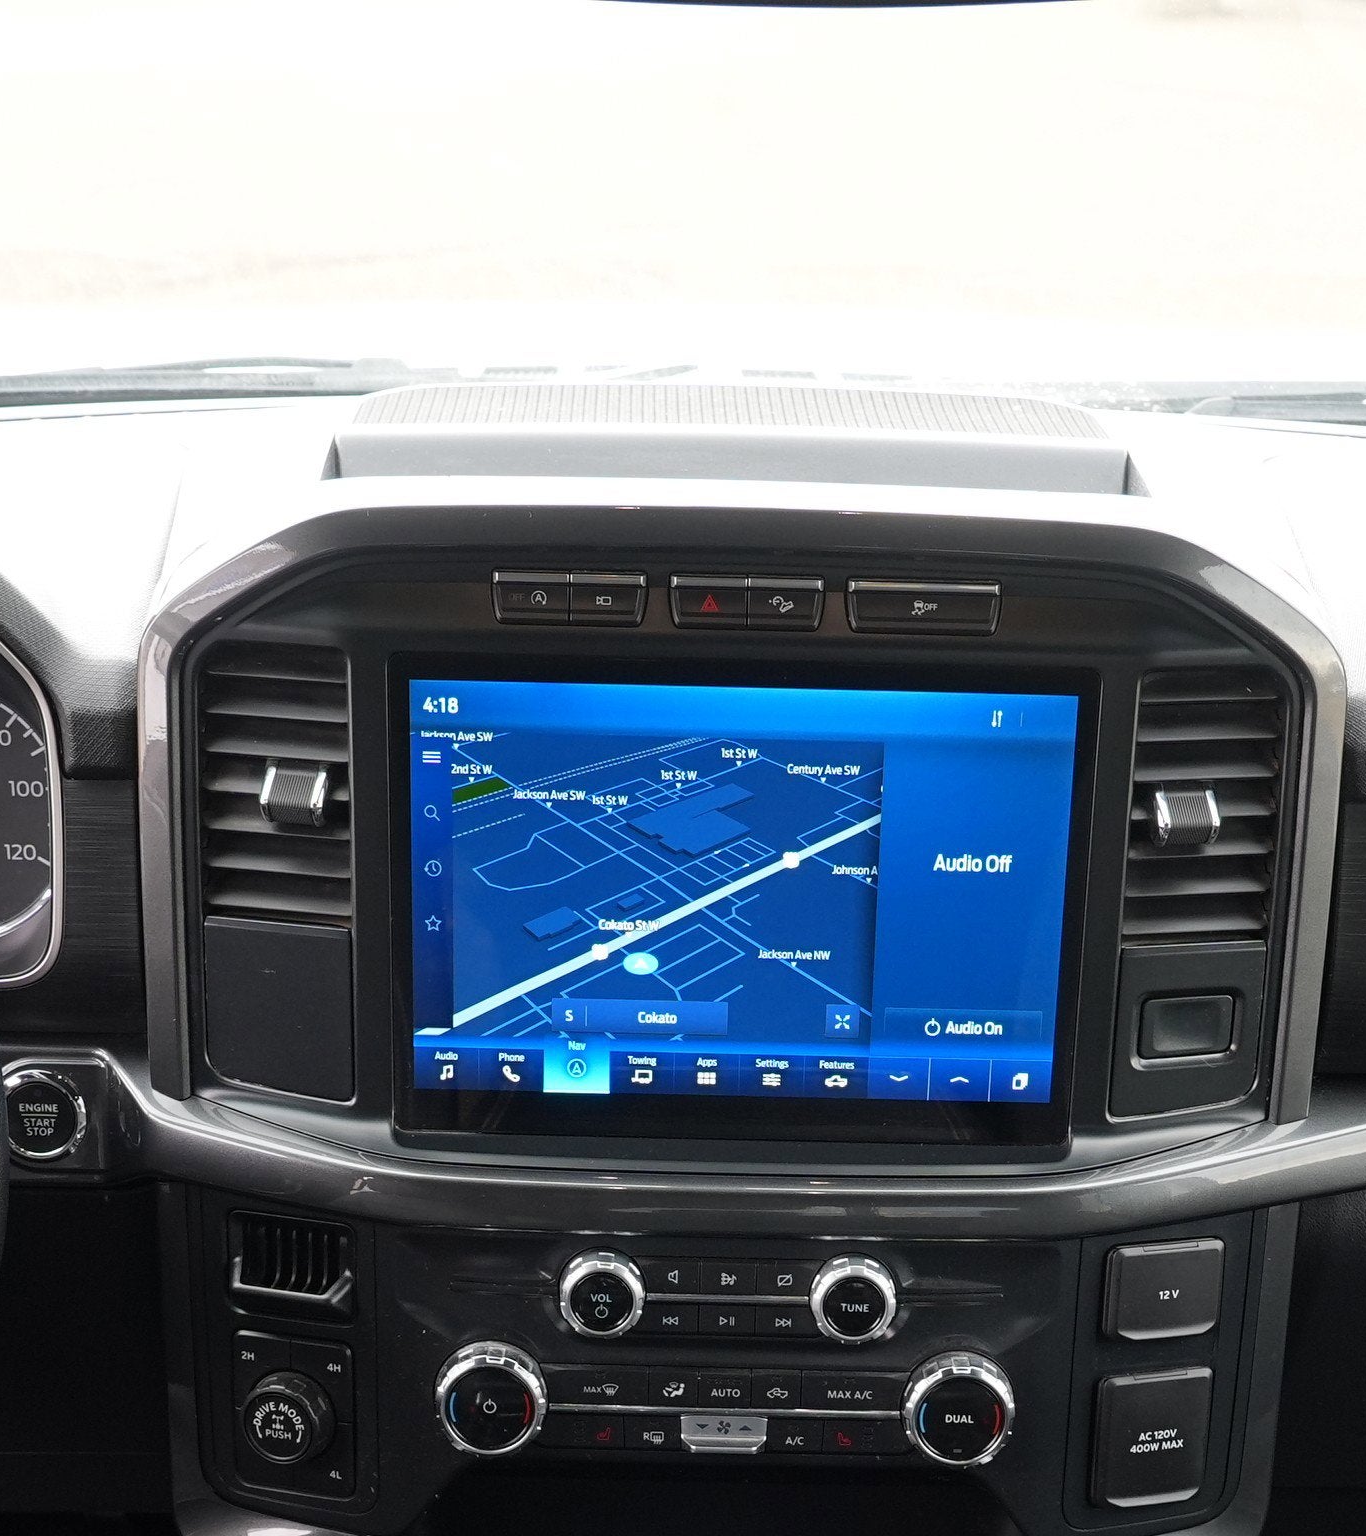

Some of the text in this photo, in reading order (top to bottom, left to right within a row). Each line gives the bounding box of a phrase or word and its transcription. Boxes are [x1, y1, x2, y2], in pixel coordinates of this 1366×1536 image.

[924, 602, 938, 611] OFF
[422, 697, 459, 714] 4:18
[457, 732, 476, 742] Ave
[476, 732, 494, 742] SW
[721, 748, 758, 758] 1st St W
[451, 764, 493, 774] 2nd St W
[660, 769, 698, 780] 1st St W
[787, 763, 861, 777] Century Ave SW
[8, 780, 44, 798] 100
[513, 789, 586, 801] Jackson Ave SW
[592, 795, 628, 805] 1st St W
[4, 843, 37, 861] 120
[933, 853, 1013, 873] Audio Off
[832, 865, 869, 875] Johnson
[598, 919, 660, 931] Cokato St W
[758, 949, 831, 961] Jackson Ave NW
[565, 1010, 574, 1022] S
[637, 1012, 678, 1024] Cokato
[945, 1020, 1003, 1035] Audio On
[568, 1040, 586, 1051] Nav
[434, 1051, 459, 1061] Audio
[498, 1052, 525, 1062] Phone
[627, 1055, 657, 1066] Towing
[696, 1057, 718, 1068] Apps
[756, 1058, 790, 1069] Settings
[819, 1060, 855, 1070] Features
[19, 1103, 59, 1113] ENGINE
[23, 1118, 56, 1128] START
[26, 1127, 54, 1137] STOP
[590, 1293, 613, 1304] VOL
[1158, 1289, 1180, 1301] 12 V
[840, 1302, 870, 1314] TUNE
[241, 1350, 255, 1361] 2H
[326, 1363, 342, 1373] 4H
[583, 1386, 602, 1394] MAX
[711, 1388, 741, 1398] AUTO
[827, 1390, 873, 1400] MAX A/C
[253, 1401, 305, 1431] DRIVE MODE
[944, 1413, 975, 1425] DUAL
[265, 1428, 292, 1440] PUSH
[1138, 1429, 1178, 1442] AC 120V
[785, 1436, 804, 1446] A/C
[1130, 1439, 1184, 1454] 400W MAX
[329, 1470, 342, 1480] 4L
